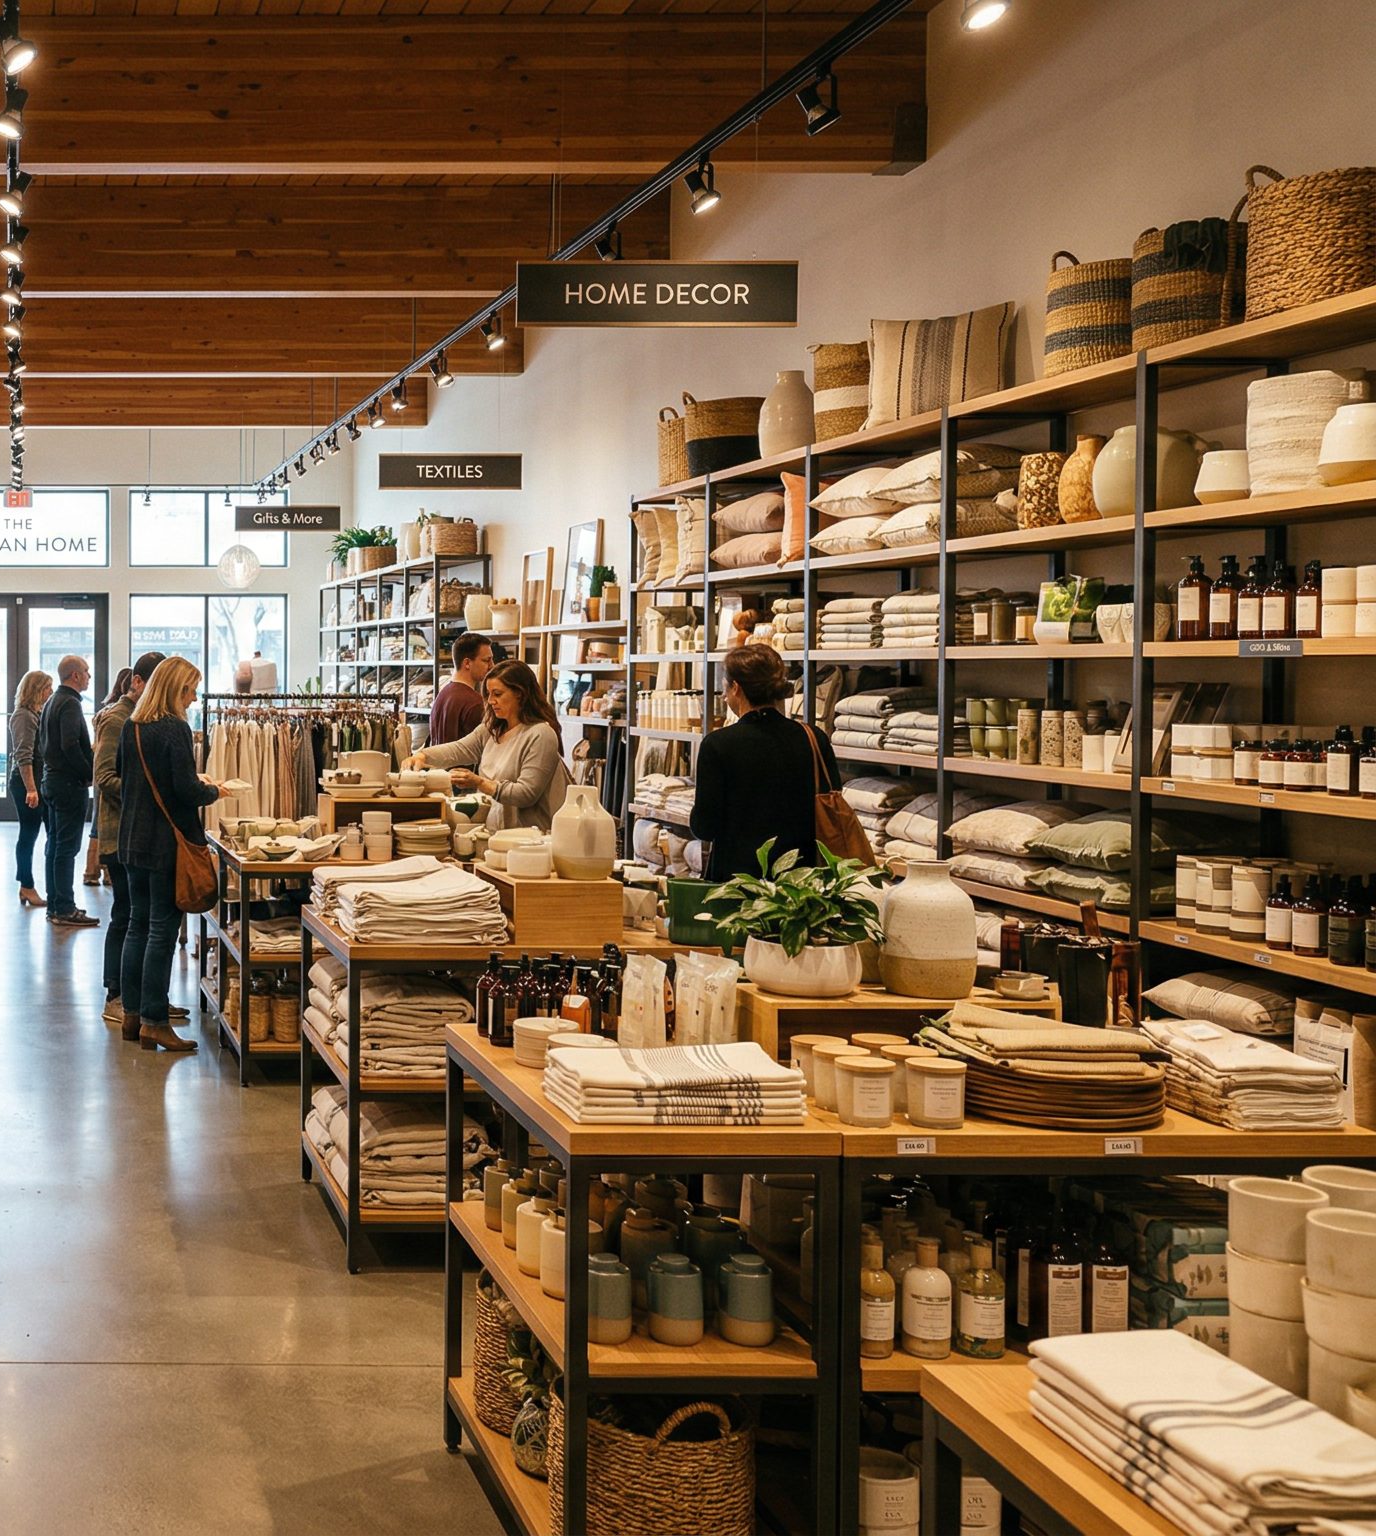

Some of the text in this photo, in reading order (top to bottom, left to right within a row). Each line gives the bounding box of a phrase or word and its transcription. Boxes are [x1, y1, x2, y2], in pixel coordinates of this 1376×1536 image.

[565, 283, 750, 305] HOME DECOR
[416, 465, 483, 479] TEXTILES
[3, 518, 33, 530] THE
[253, 512, 323, 524] Gifts & More
[36, 537, 97, 552] HOME
